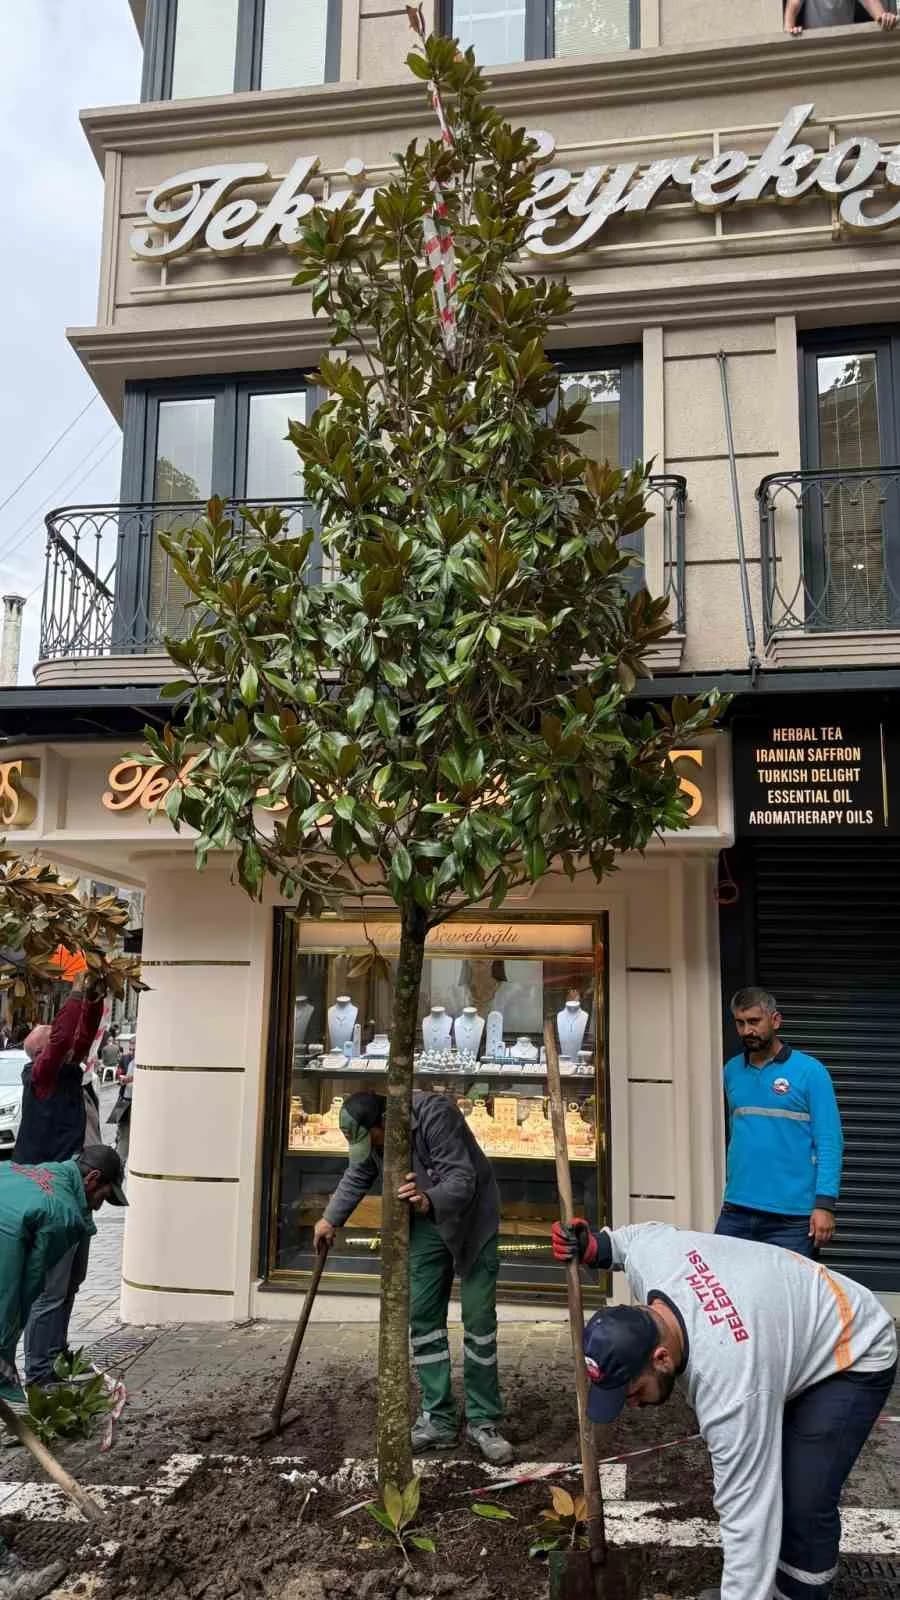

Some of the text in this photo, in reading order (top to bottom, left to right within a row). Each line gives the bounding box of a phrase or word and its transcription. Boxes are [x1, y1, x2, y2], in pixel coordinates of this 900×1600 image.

[773, 726, 843, 742] HERBAL TEA
[756, 747, 861, 763] IRANIAN SAFFRON
[758, 768, 861, 783] TURKISH DELIGHT
[767, 789, 853, 804] ESSENTIAL OIL
[749, 810, 873, 825] AROMATHERAPY OILS
